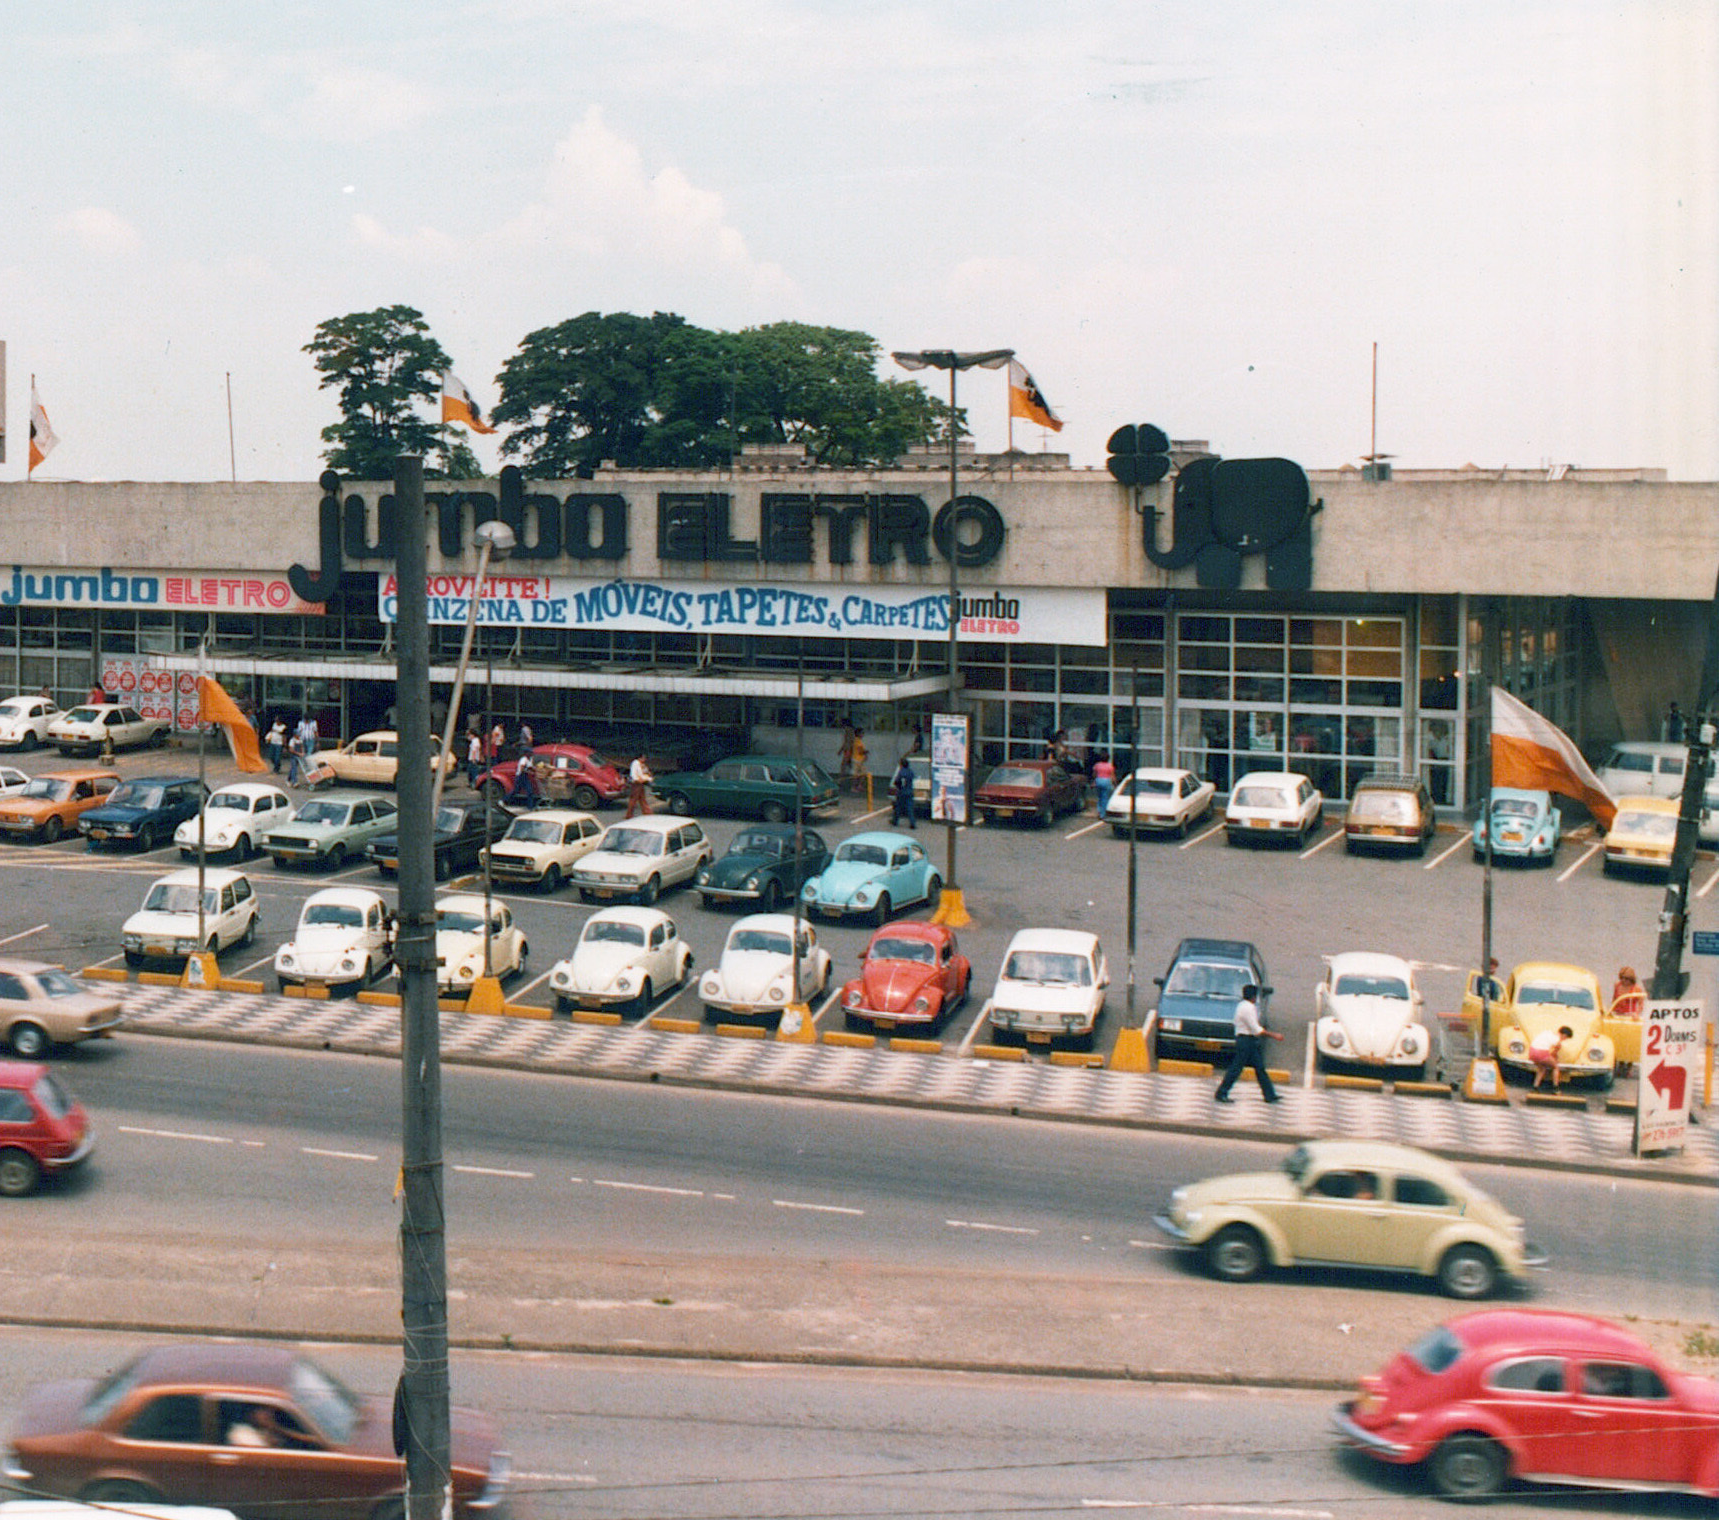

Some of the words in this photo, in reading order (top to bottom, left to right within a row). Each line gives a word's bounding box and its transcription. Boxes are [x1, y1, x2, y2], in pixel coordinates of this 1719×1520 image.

[288, 465, 631, 603] jumbo
[657, 492, 1005, 567] ELETRO
[1, 565, 158, 605] jumbo
[166, 577, 291, 607] ELETRO
[532, 598, 568, 624] DE
[697, 587, 828, 626] TAPETES
[828, 612, 842, 631] &
[842, 595, 951, 631] CARPETES
[948, 590, 1020, 624] jumbo
[961, 618, 1021, 635] ELETRO
[1650, 1008, 1699, 1019] APTOS
[1647, 1025, 1662, 1055] 2
